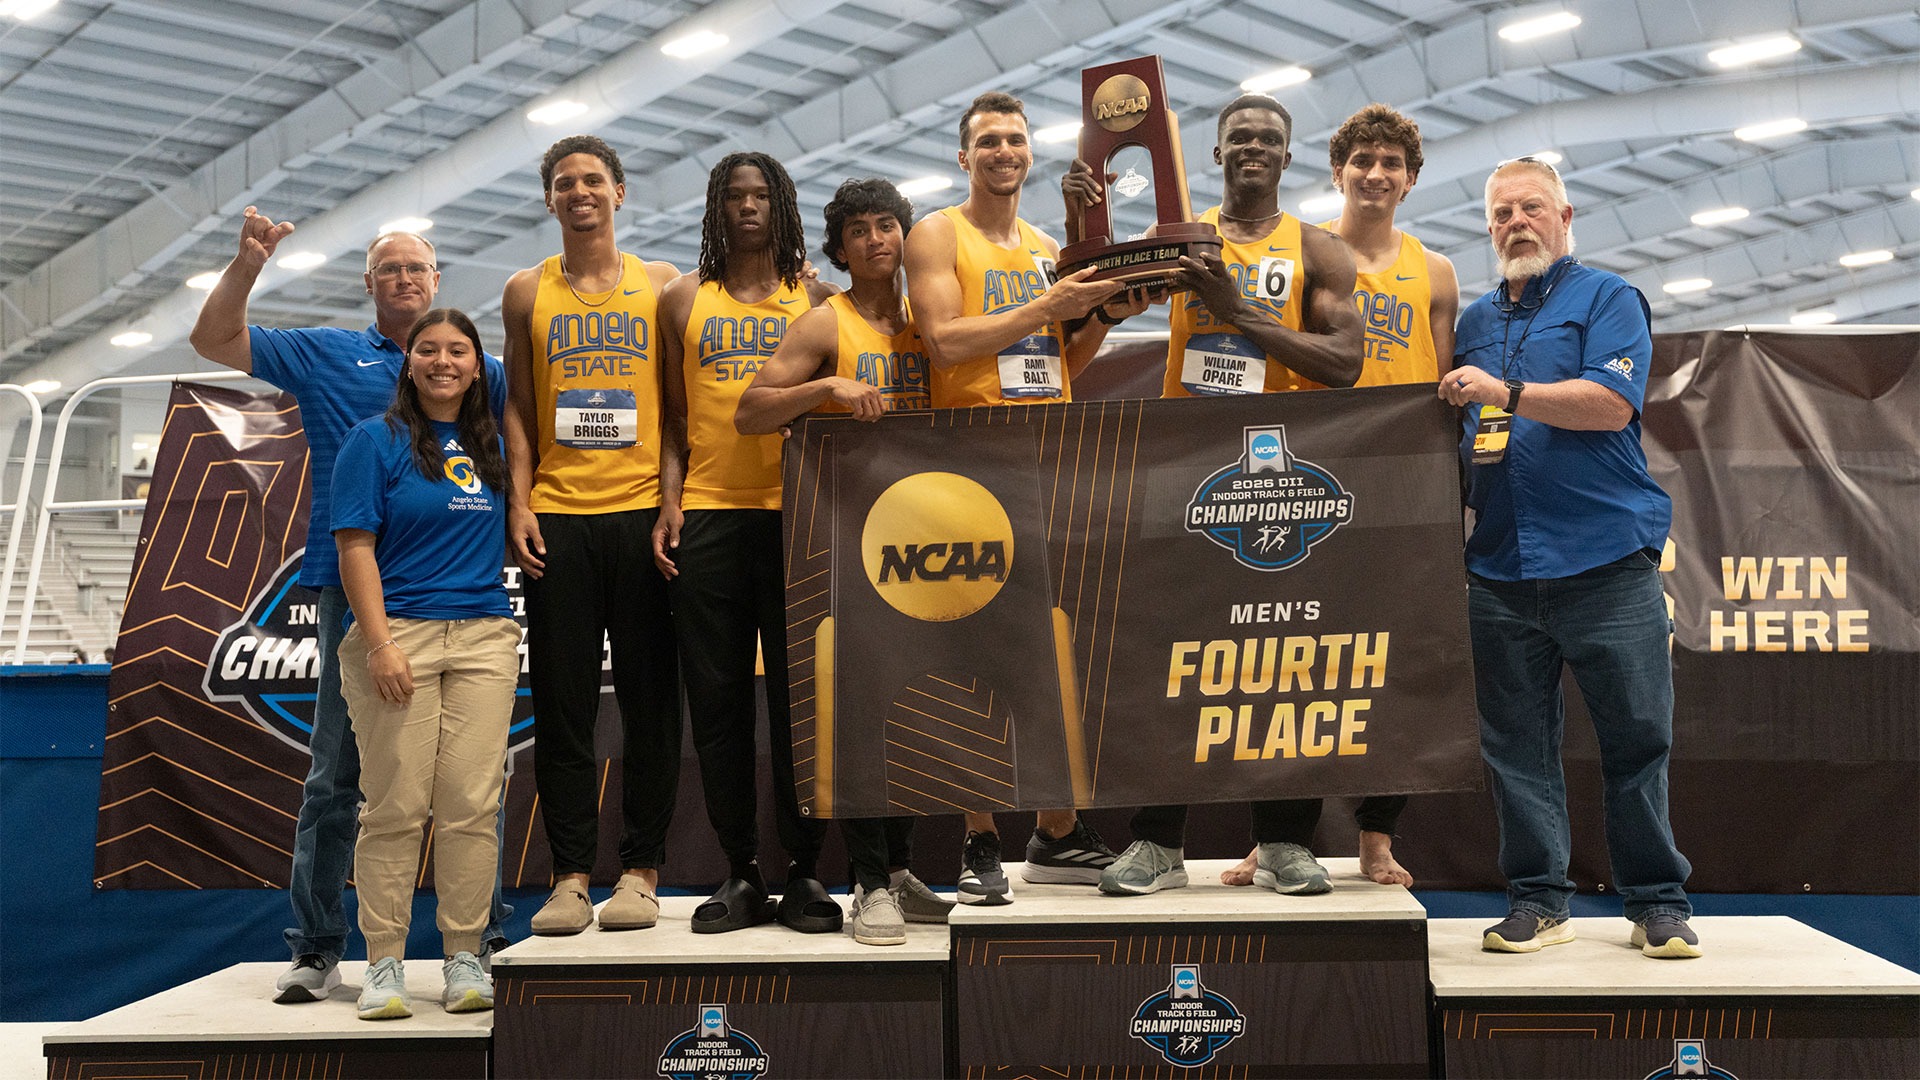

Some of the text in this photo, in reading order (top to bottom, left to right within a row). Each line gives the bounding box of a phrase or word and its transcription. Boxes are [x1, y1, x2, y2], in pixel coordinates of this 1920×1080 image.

[1097, 96, 1148, 120] NCAA
[1123, 250, 1151, 265] PLACE
[1153, 247, 1179, 259] TEAM
[1265, 260, 1286, 297] 6
[983, 269, 1047, 313] Ange
[547, 312, 648, 357] Angelo
[699, 316, 787, 359] Angel
[856, 352, 931, 391] Angel
[1024, 359, 1046, 370] RAMI
[1204, 355, 1247, 372] WILLIAM
[1023, 371, 1050, 384] BALTI
[1202, 369, 1243, 387] OPARE
[579, 412, 614, 423] TAYLOR
[574, 425, 619, 438] BRIGGS
[1254, 446, 1279, 454] NCAA
[1232, 477, 1304, 490] 2026 DII
[452, 496, 473, 504] Angelo
[1212, 488, 1325, 501] INDOOR TRACK & FIELD
[448, 503, 493, 511] Sports Medicine
[1191, 499, 1348, 525] CHAMPIONSHIPS
[878, 541, 1006, 584] NCAA
[1721, 556, 1847, 600] WIN
[1230, 601, 1320, 624] MEN'S
[1710, 610, 1870, 652] HERE
[1166, 632, 1389, 697] FOURTH
[1194, 699, 1371, 763] PLACE
[1157, 1010, 1184, 1018] TRACK
[1186, 1010, 1192, 1018] &
[1133, 1019, 1242, 1033] CHAMPIONSHIPS
[661, 1058, 765, 1071] CHAMPIONSHIPS
